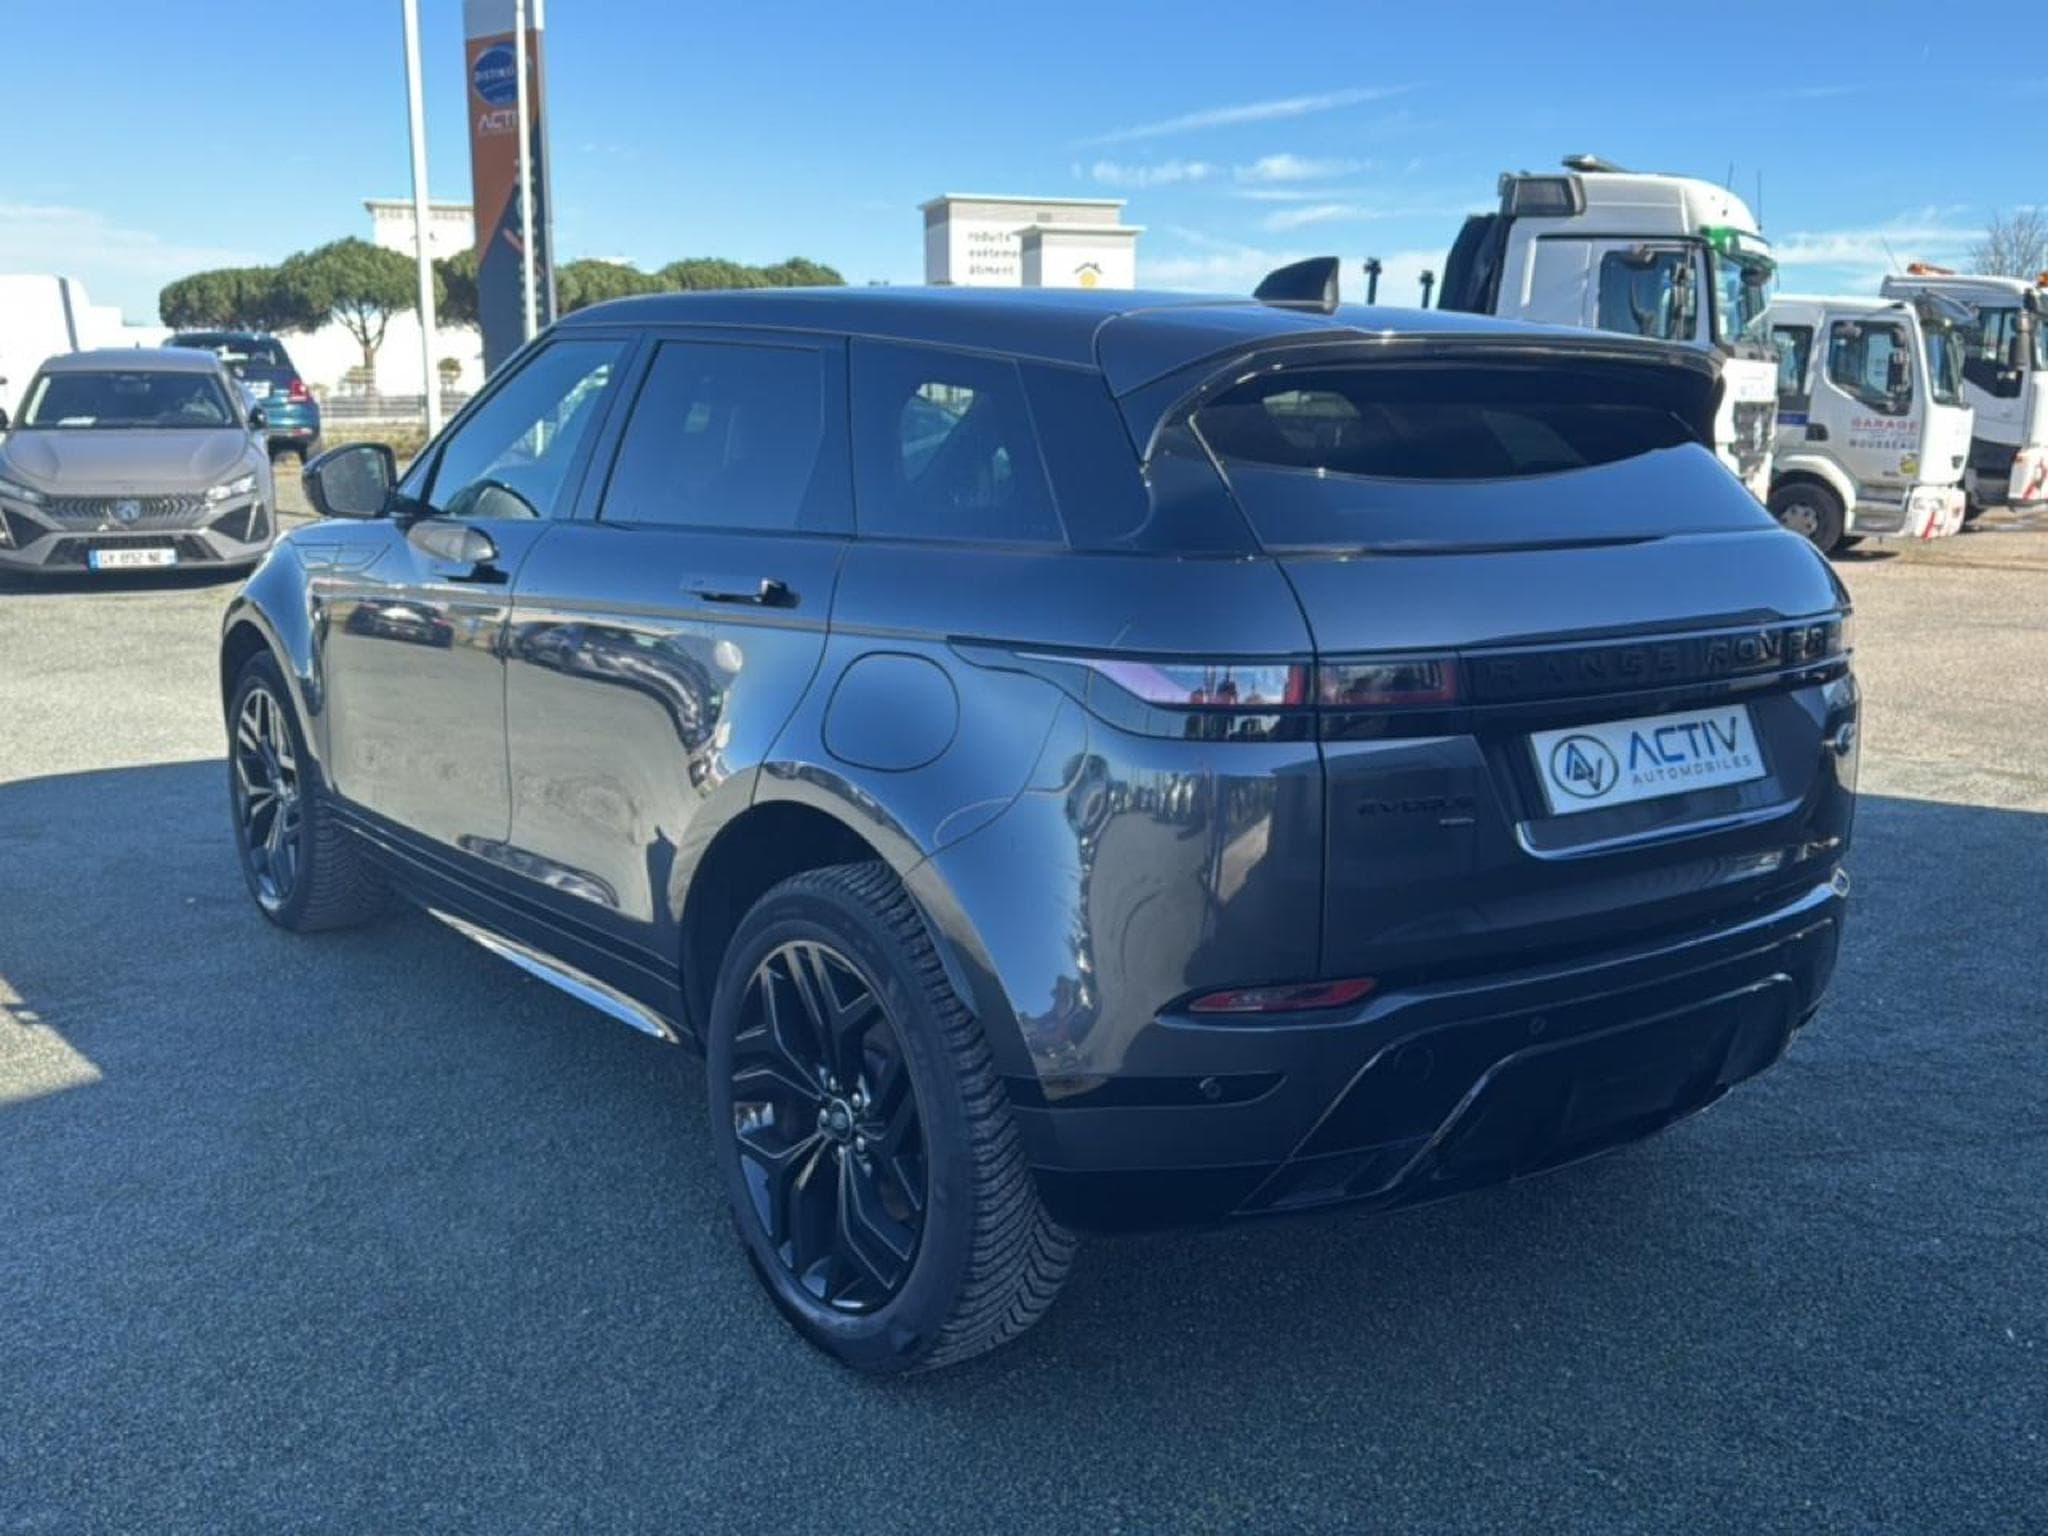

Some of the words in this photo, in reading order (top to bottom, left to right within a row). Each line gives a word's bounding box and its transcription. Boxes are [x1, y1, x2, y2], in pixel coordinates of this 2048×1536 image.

[1851, 417, 1920, 430] GARAGE
[1489, 647, 1680, 684] RANGE
[1705, 628, 1827, 667] ROVER
[1629, 716, 1737, 769] ACTIV
[1632, 754, 1752, 785] AUTOMOBILES
